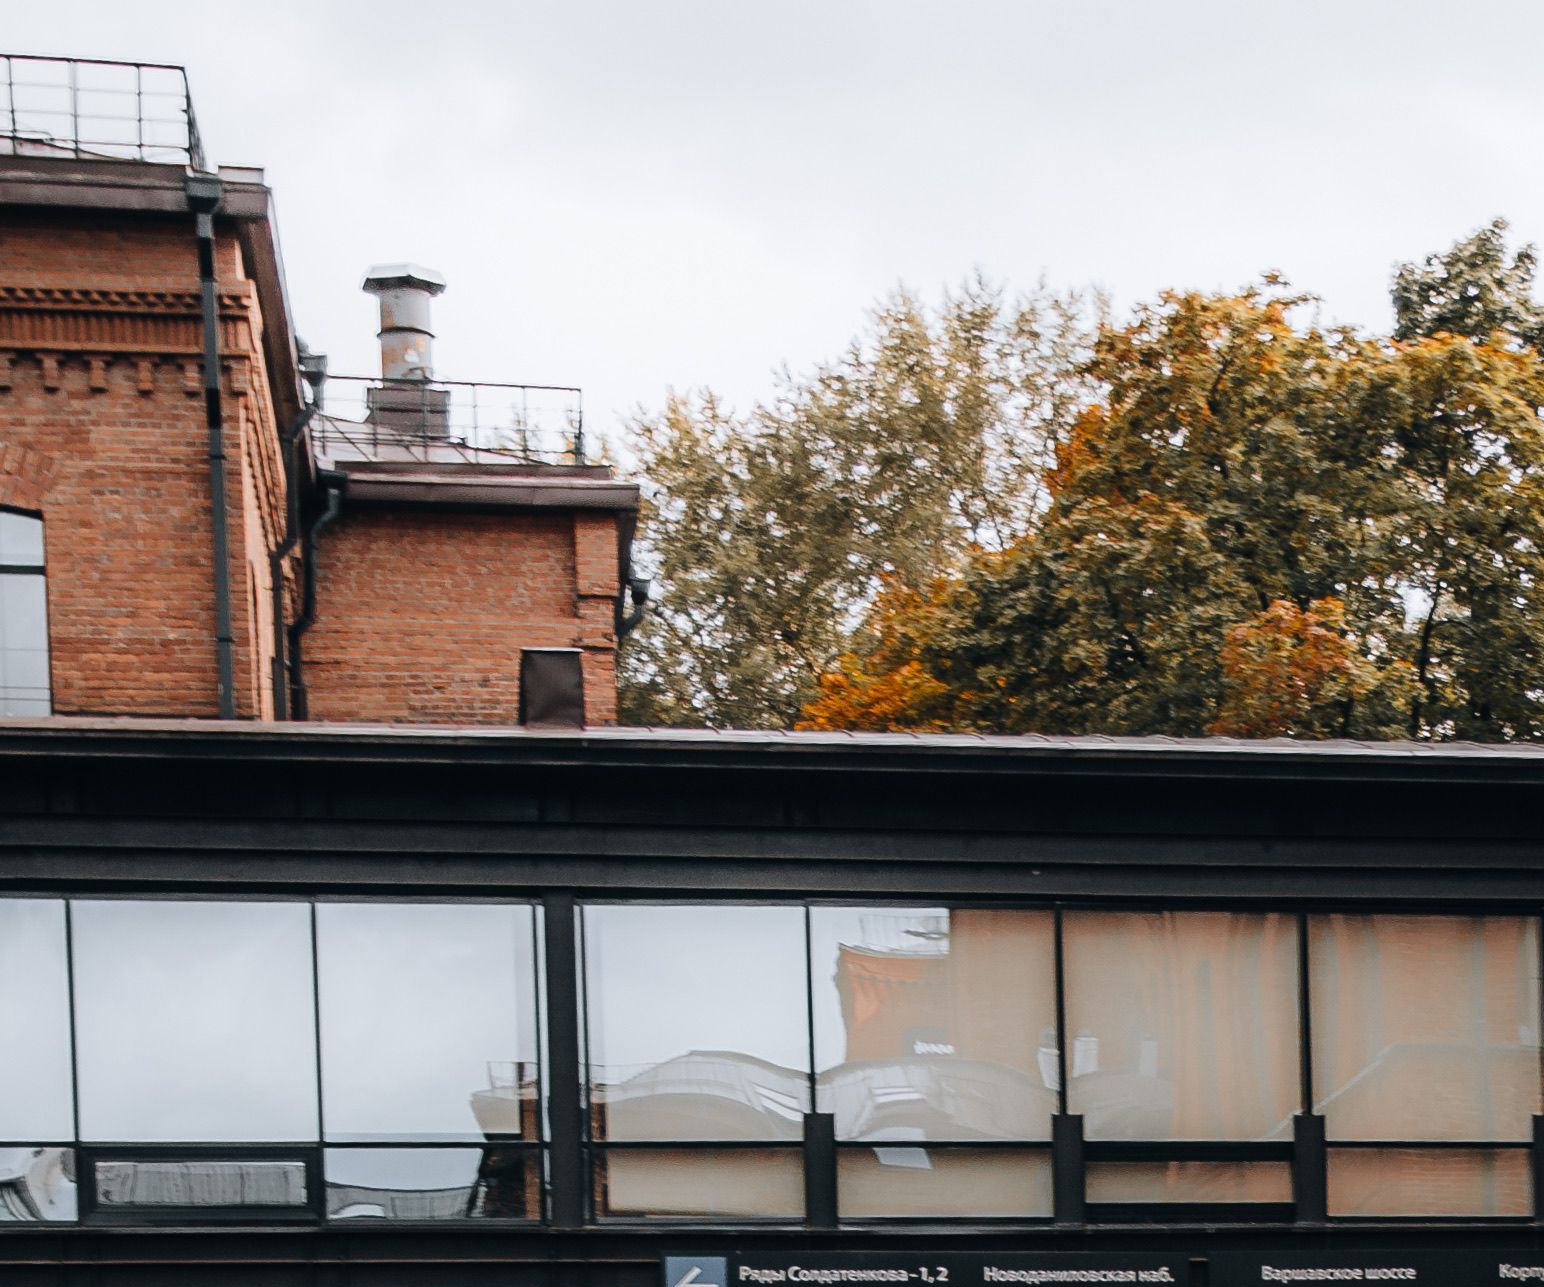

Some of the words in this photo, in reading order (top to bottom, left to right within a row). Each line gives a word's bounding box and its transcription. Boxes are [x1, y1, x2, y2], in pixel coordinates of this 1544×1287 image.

[738, 1265, 786, 1283] Ряды
[936, 1266, 950, 1282] 2
[983, 1266, 1136, 1284] Новоданиловская
[1138, 1266, 1175, 1283] наб.
[1261, 1265, 1363, 1284] Варшавское
[1365, 1267, 1417, 1280] шоссе
